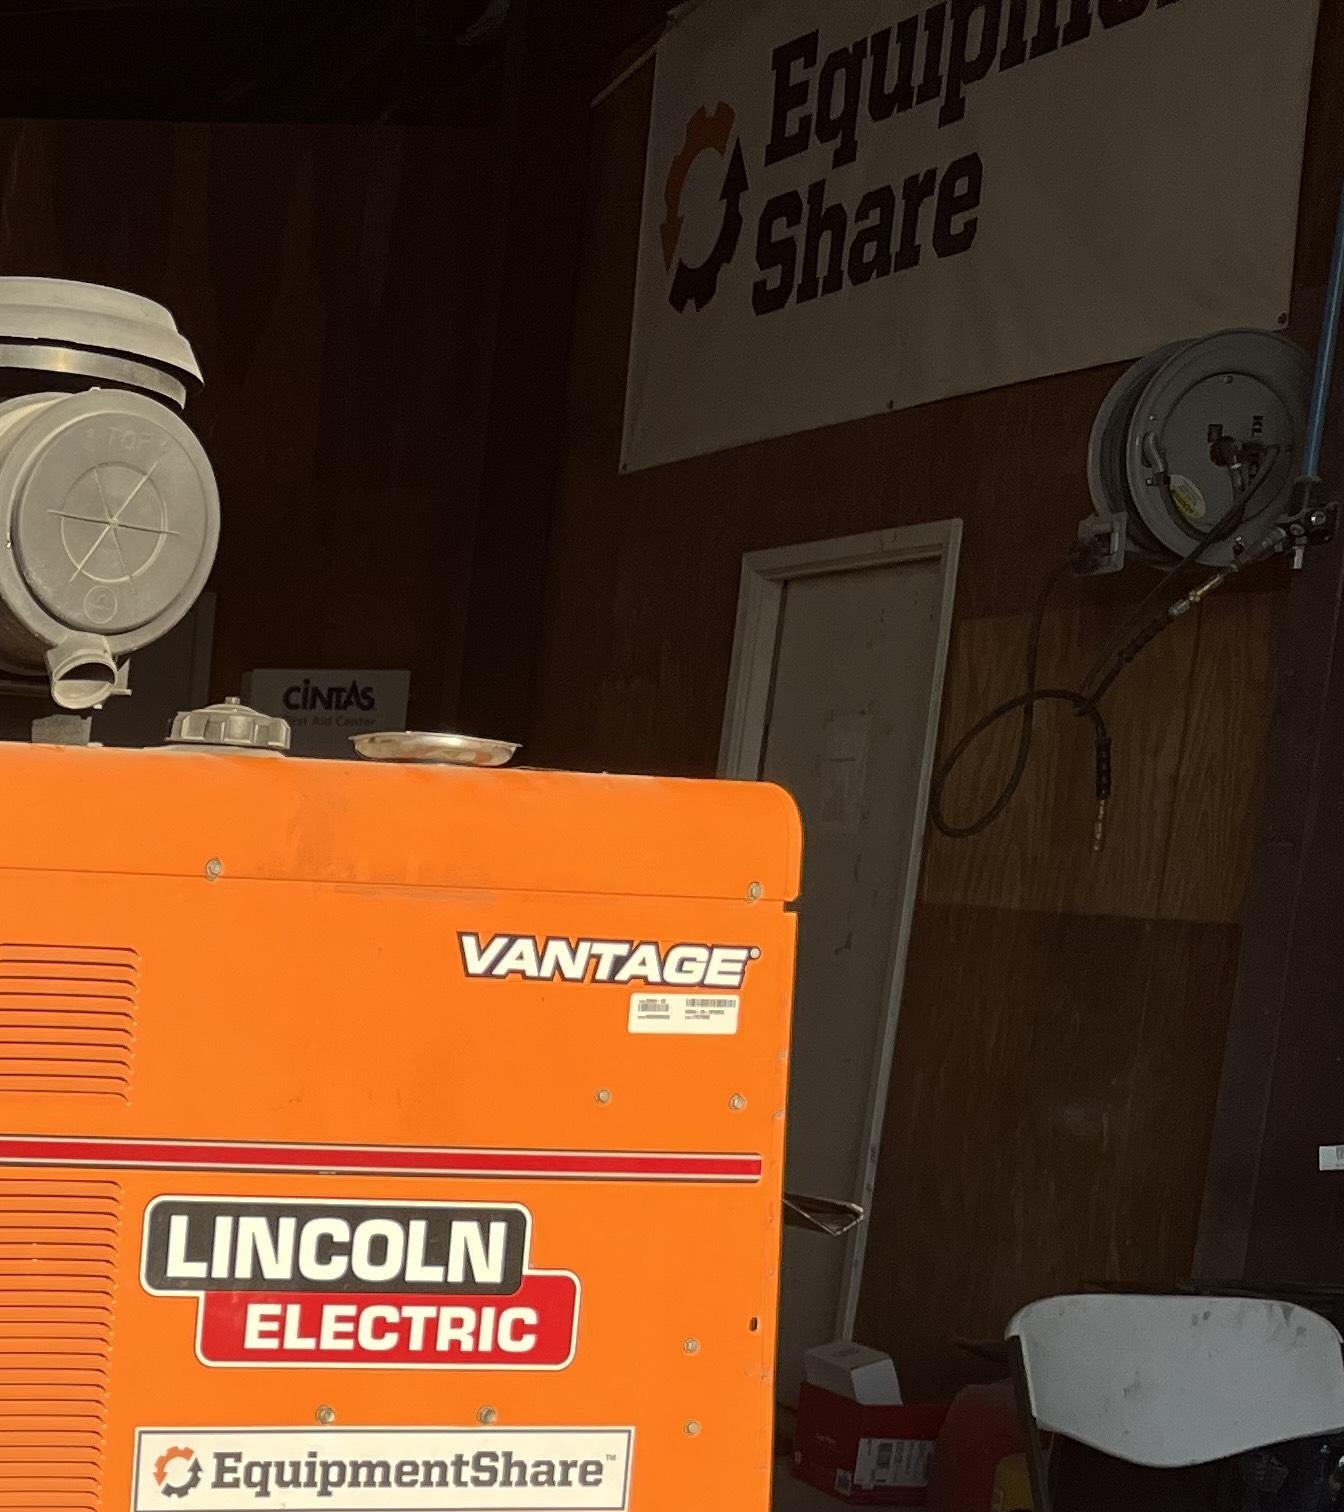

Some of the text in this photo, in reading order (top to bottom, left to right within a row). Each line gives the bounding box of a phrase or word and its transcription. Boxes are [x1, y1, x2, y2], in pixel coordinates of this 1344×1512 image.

[765, 0, 1180, 169] Equipm
[751, 151, 983, 316] Share
[282, 678, 376, 711] CINTAS
[457, 932, 751, 989] VANTAGE
[164, 1214, 509, 1284] LINCOLN
[243, 1304, 539, 1353] ELECTRIC
[211, 1450, 603, 1498] EquipmentShare
